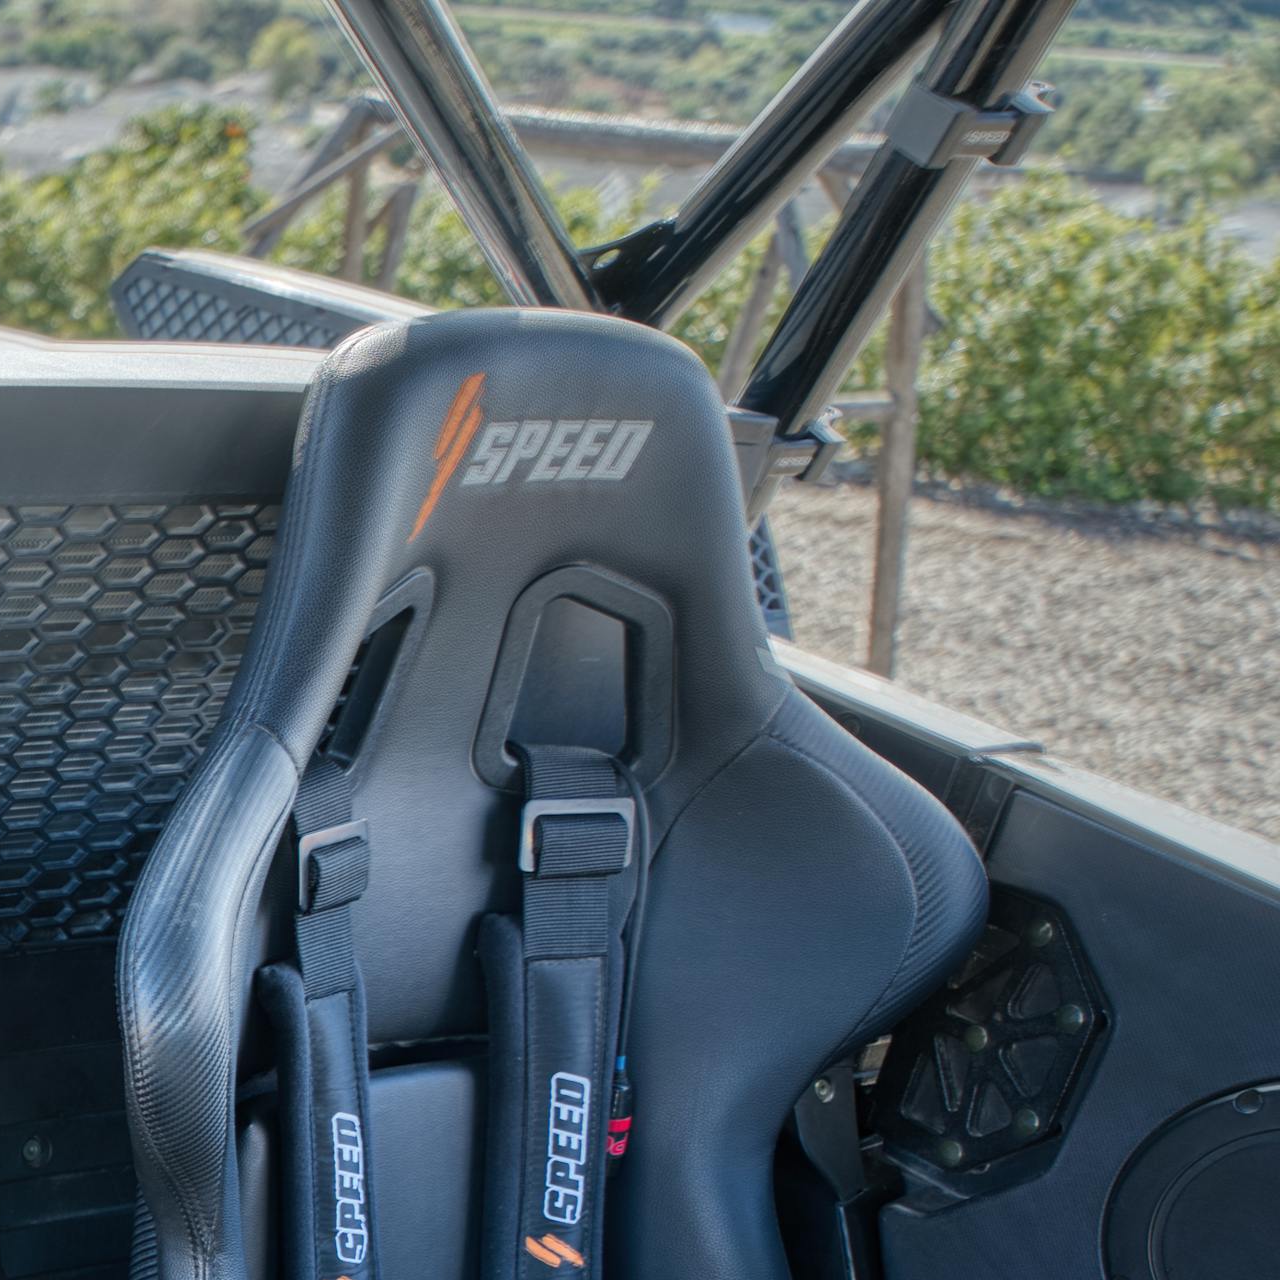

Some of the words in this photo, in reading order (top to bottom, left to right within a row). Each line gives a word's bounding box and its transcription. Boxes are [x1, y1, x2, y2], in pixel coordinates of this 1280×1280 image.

[458, 419, 654, 486] SPEED
[332, 1111, 368, 1264] SPEED
[543, 1071, 591, 1225] SPEED
